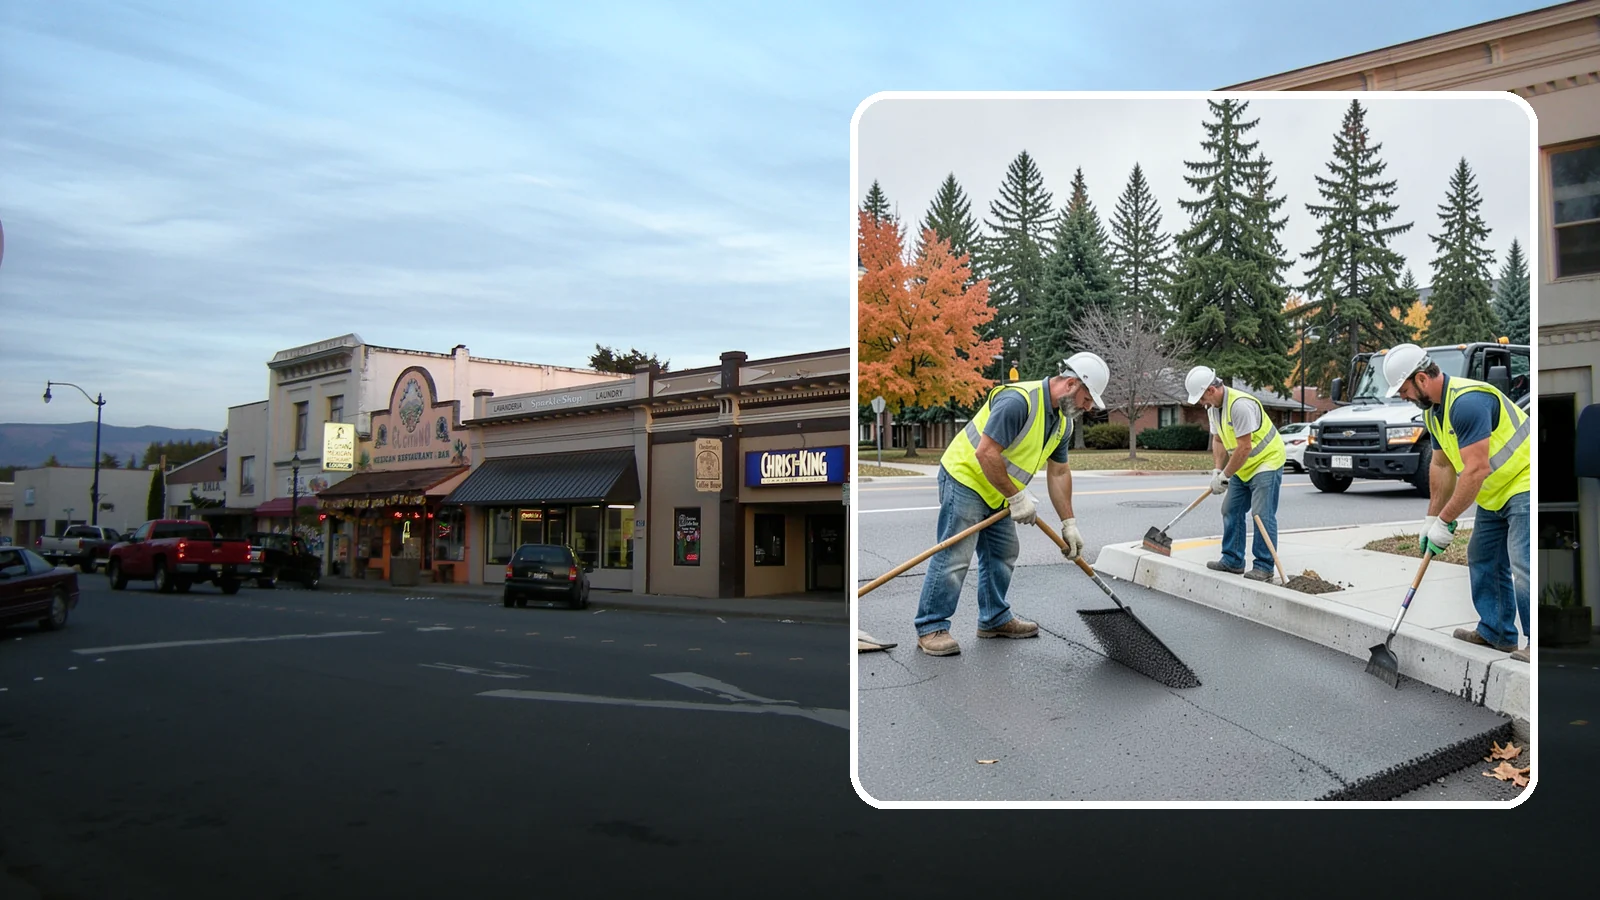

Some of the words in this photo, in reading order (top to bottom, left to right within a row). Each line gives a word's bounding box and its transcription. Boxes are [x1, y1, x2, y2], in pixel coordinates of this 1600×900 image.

[493, 402, 523, 412] LAVANDERIA
[531, 397, 560, 408] Sparkle
[562, 395, 582, 406] Shop
[595, 389, 624, 399] LAUNDRY
[373, 455, 396, 464] MEXICAN
[397, 451, 433, 462] RESTAURANT
[437, 450, 450, 459] BAR
[760, 451, 797, 478] CHRIST
[799, 449, 827, 476] KING
